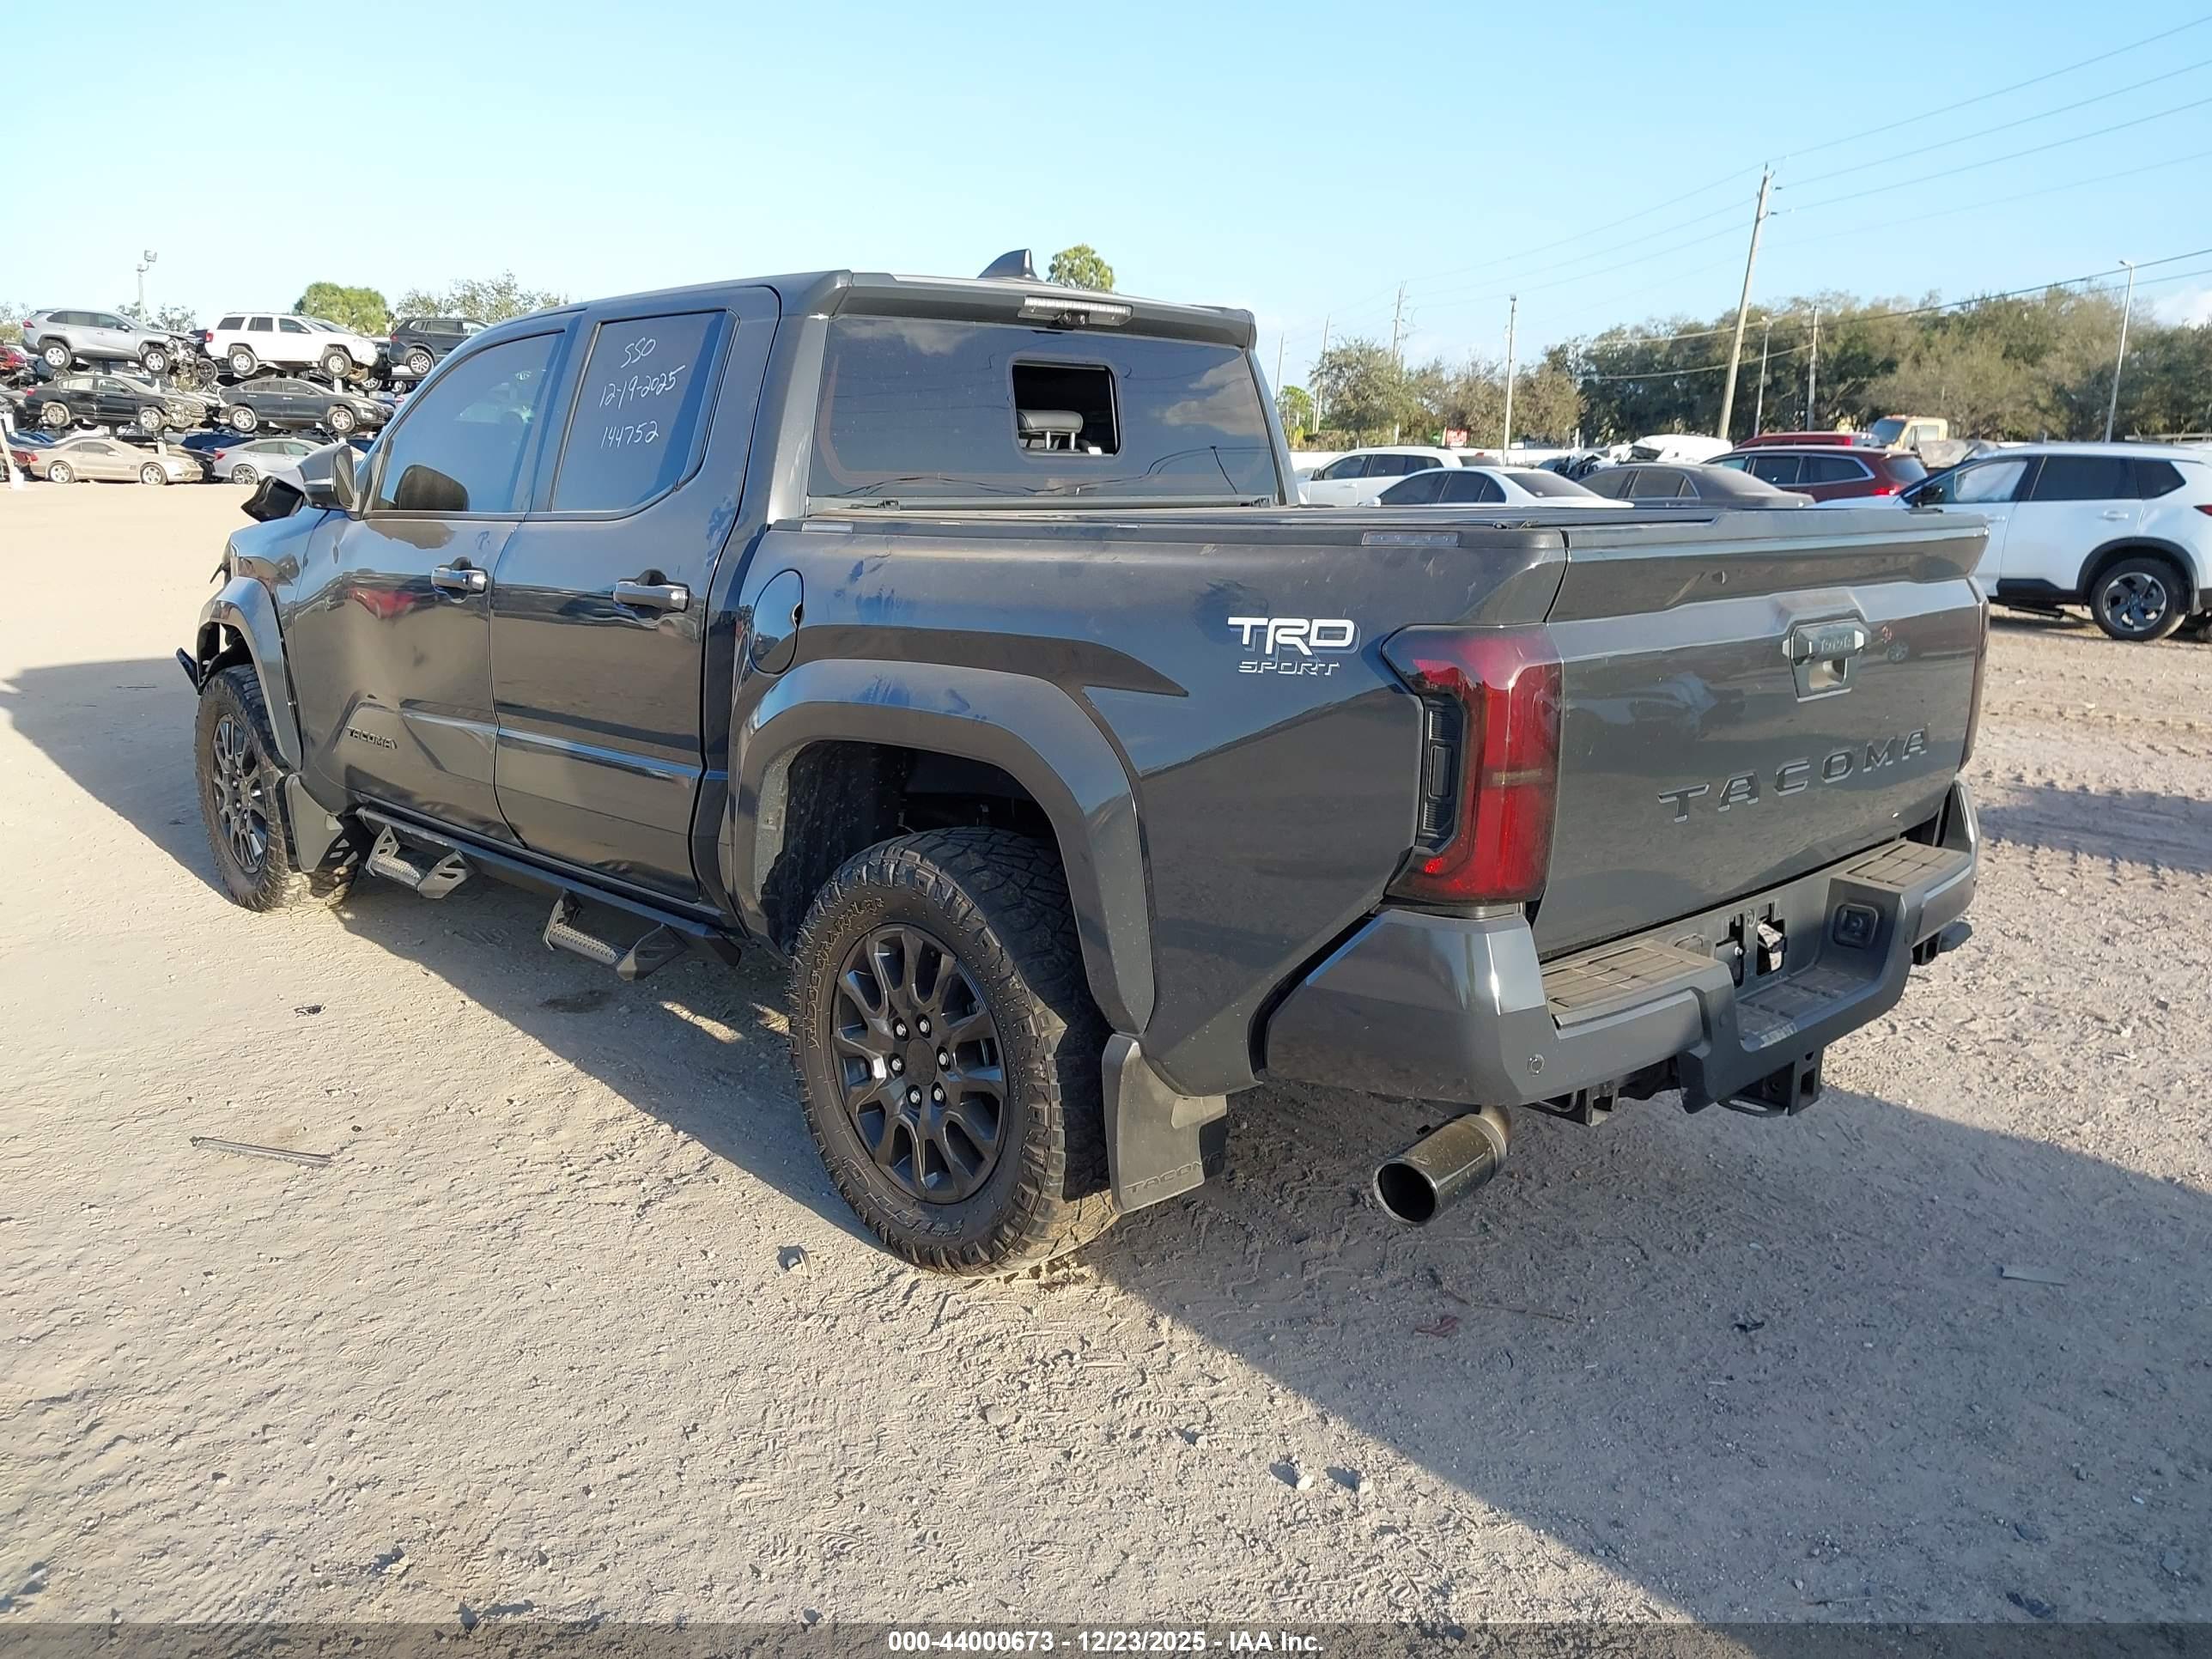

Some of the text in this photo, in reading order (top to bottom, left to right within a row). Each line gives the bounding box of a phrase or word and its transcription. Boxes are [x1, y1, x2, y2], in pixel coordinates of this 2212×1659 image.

[599, 365, 685, 410] 12-19-2025
[601, 421, 659, 448] 144752
[1227, 617, 1358, 657] TRD
[1238, 659, 1340, 676] SPORT
[347, 726, 398, 750] TACOMA
[1657, 728, 1929, 823] TACOMA
